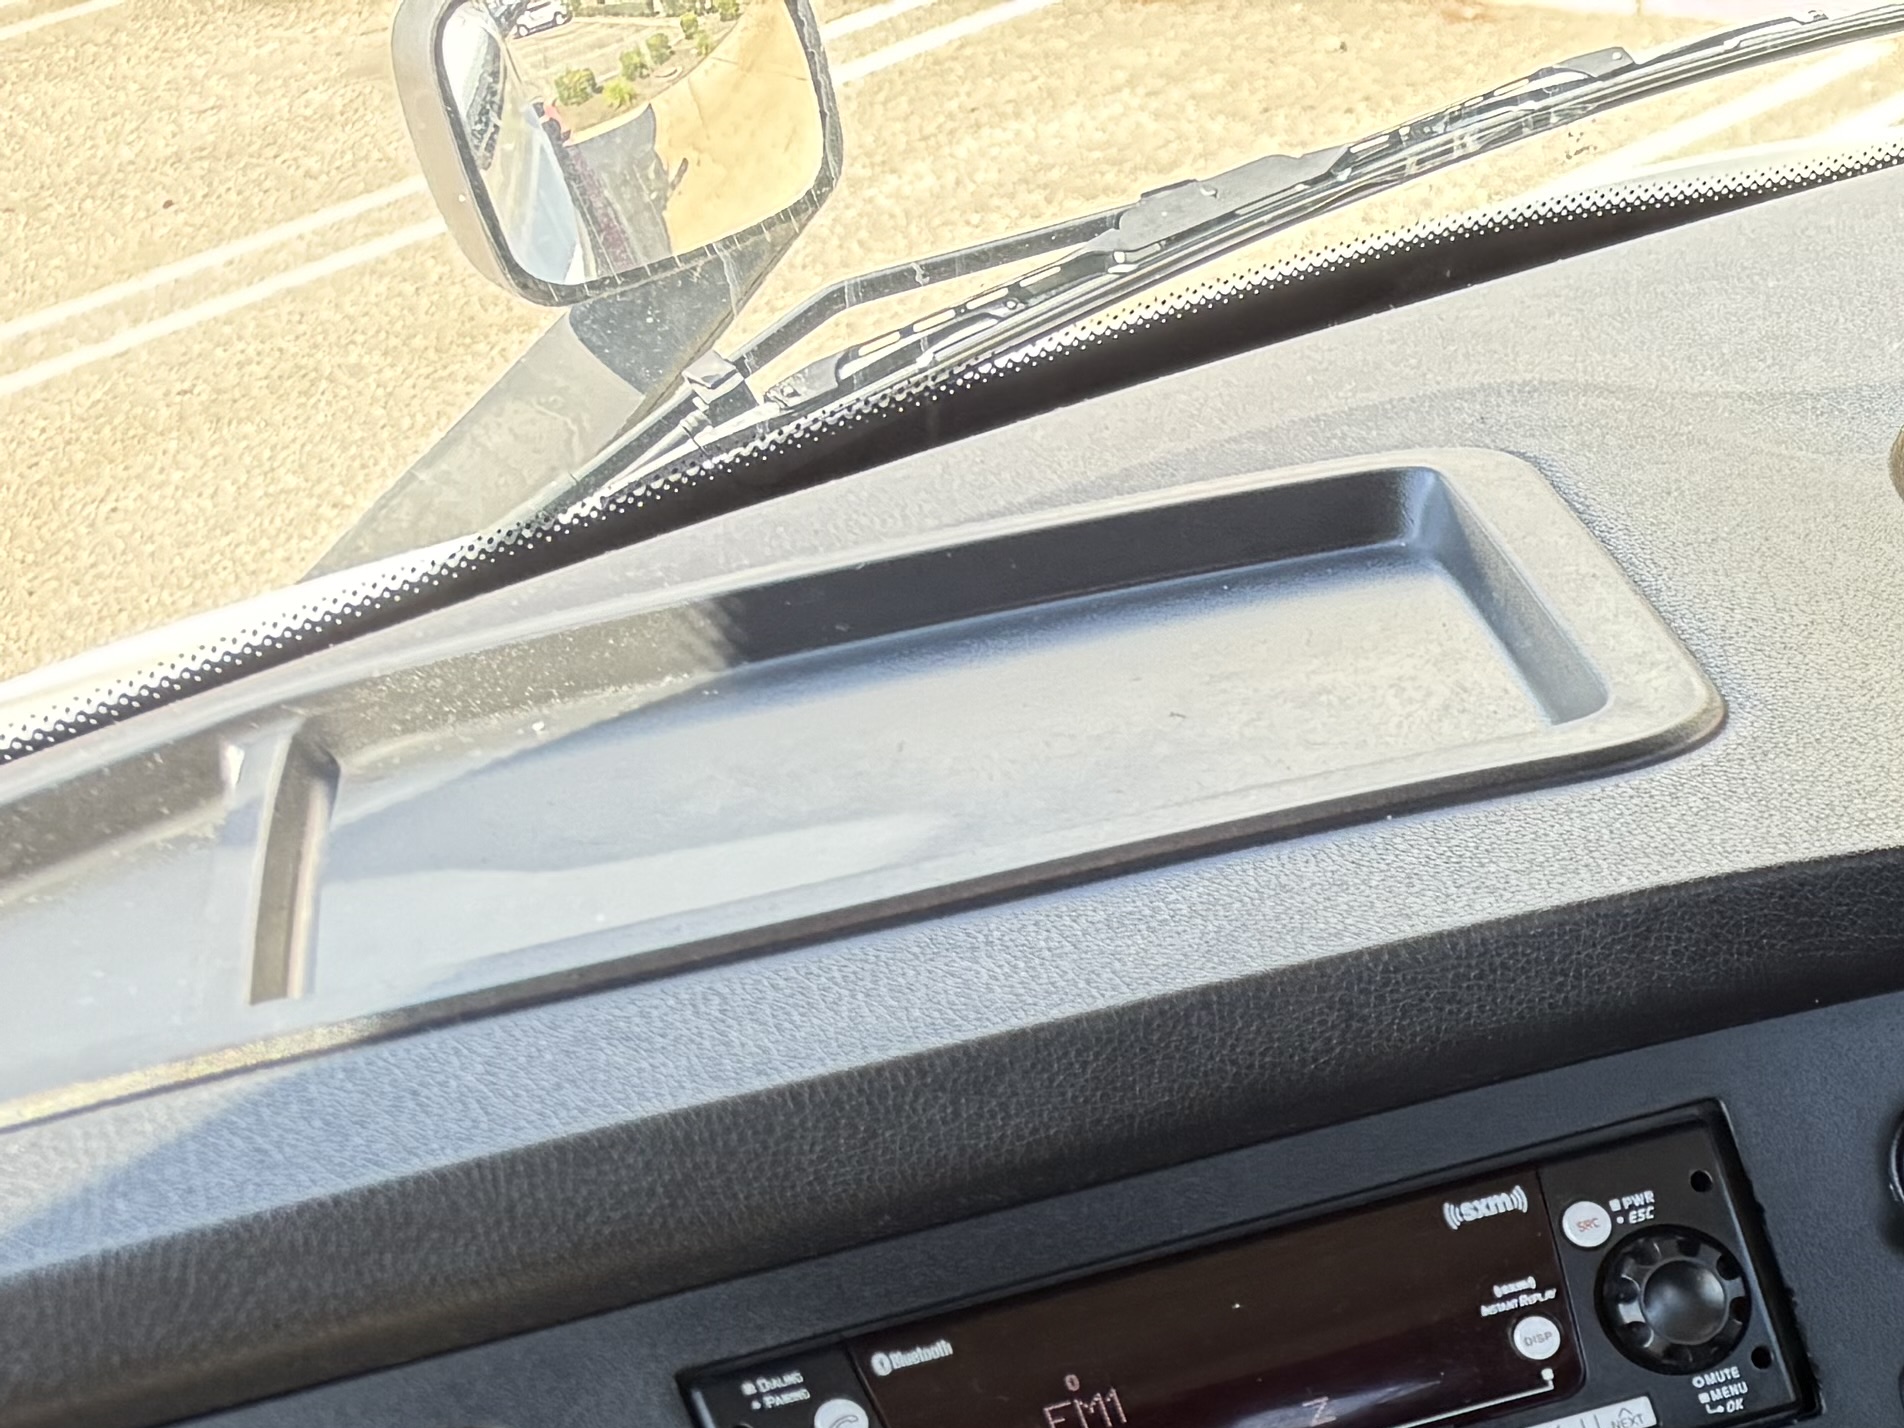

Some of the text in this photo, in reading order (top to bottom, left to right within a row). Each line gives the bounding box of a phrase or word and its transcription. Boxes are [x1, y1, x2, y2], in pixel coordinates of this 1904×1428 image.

[1621, 1190, 1655, 1210] PWR
[1629, 1206, 1655, 1224] ESC
[1576, 1217, 1601, 1233] SRC
[1523, 1331, 1553, 1348] DISP
[889, 1339, 953, 1369] Bluetooth
[1704, 1366, 1740, 1386] MUTE
[1710, 1381, 1749, 1402] MENU
[1726, 1398, 1744, 1413] OK
